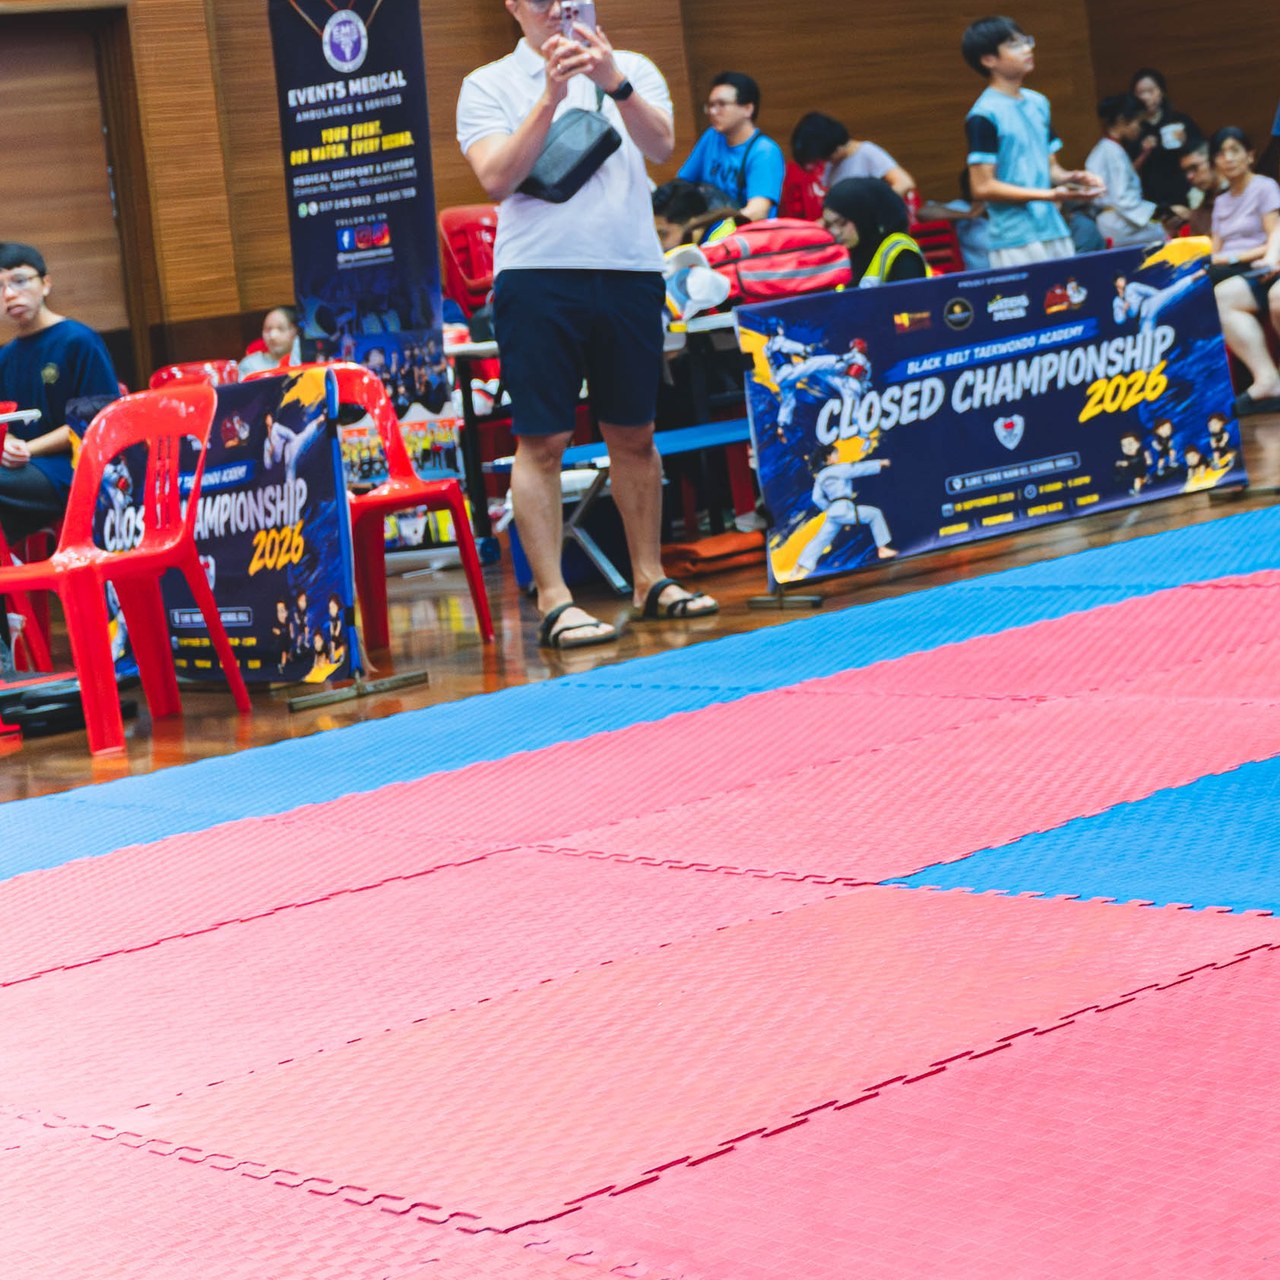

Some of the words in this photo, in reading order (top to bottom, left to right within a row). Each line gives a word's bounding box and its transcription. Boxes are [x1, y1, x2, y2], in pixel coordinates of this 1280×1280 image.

[287, 80, 347, 108] EVENTS
[348, 69, 408, 97] MEDICAL
[907, 357, 942, 375] BLACK
[945, 349, 971, 367] BELT
[974, 336, 1036, 359] TAEKWONDO
[1038, 325, 1084, 345] ACADEMY
[815, 376, 945, 445] CLOSED
[951, 324, 1176, 414] CHAMPIONSHIP
[1078, 360, 1169, 424] 2026
[248, 519, 305, 577] 2026
